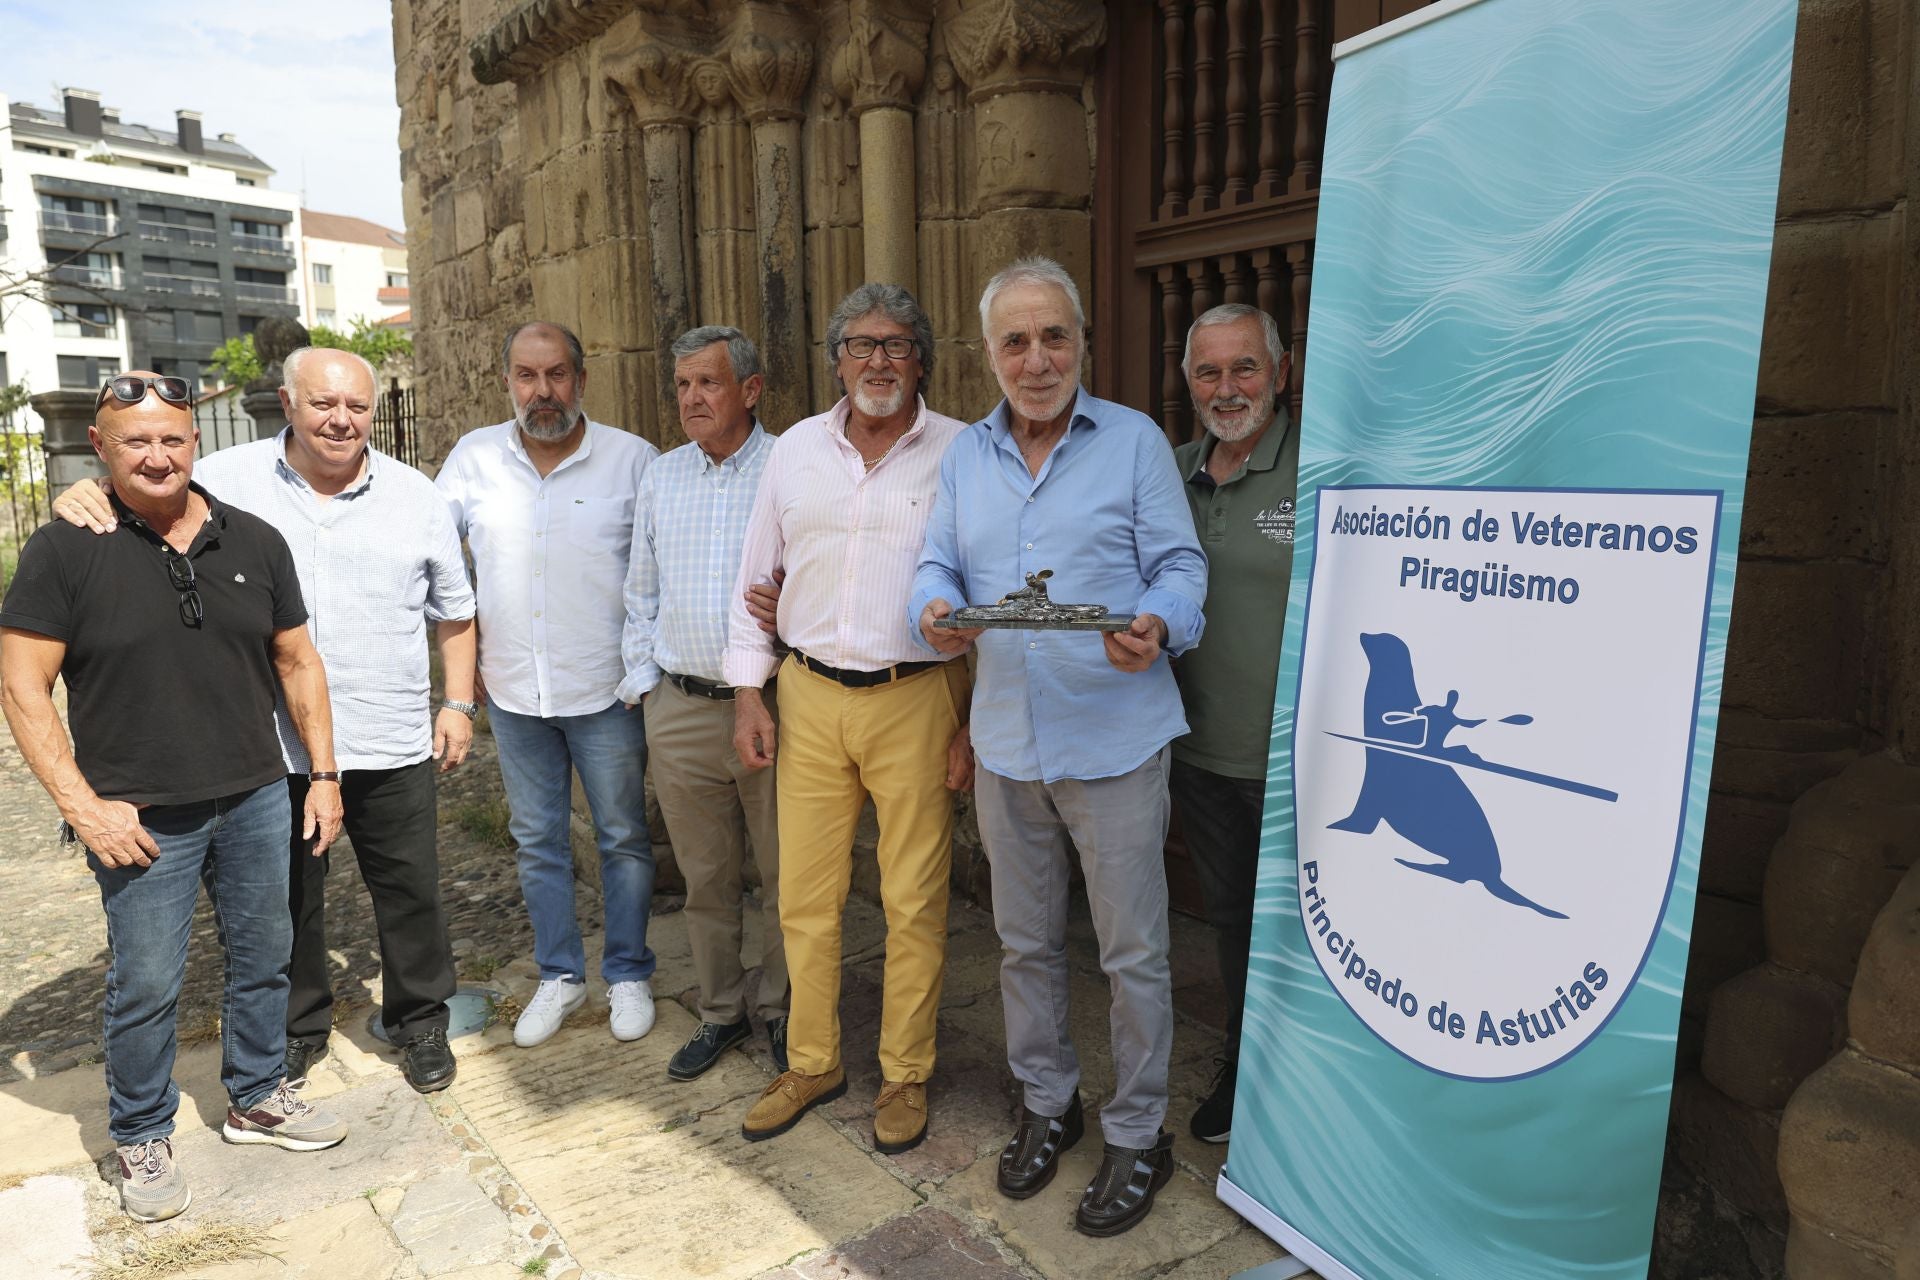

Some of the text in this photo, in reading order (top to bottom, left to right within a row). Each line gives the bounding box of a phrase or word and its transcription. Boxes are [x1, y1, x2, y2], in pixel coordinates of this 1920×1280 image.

[1331, 505, 1699, 555] Asociación de Veteranos
[1400, 557, 1580, 604] Piragüismo
[1303, 861, 1609, 1047] Principado de Asturias
